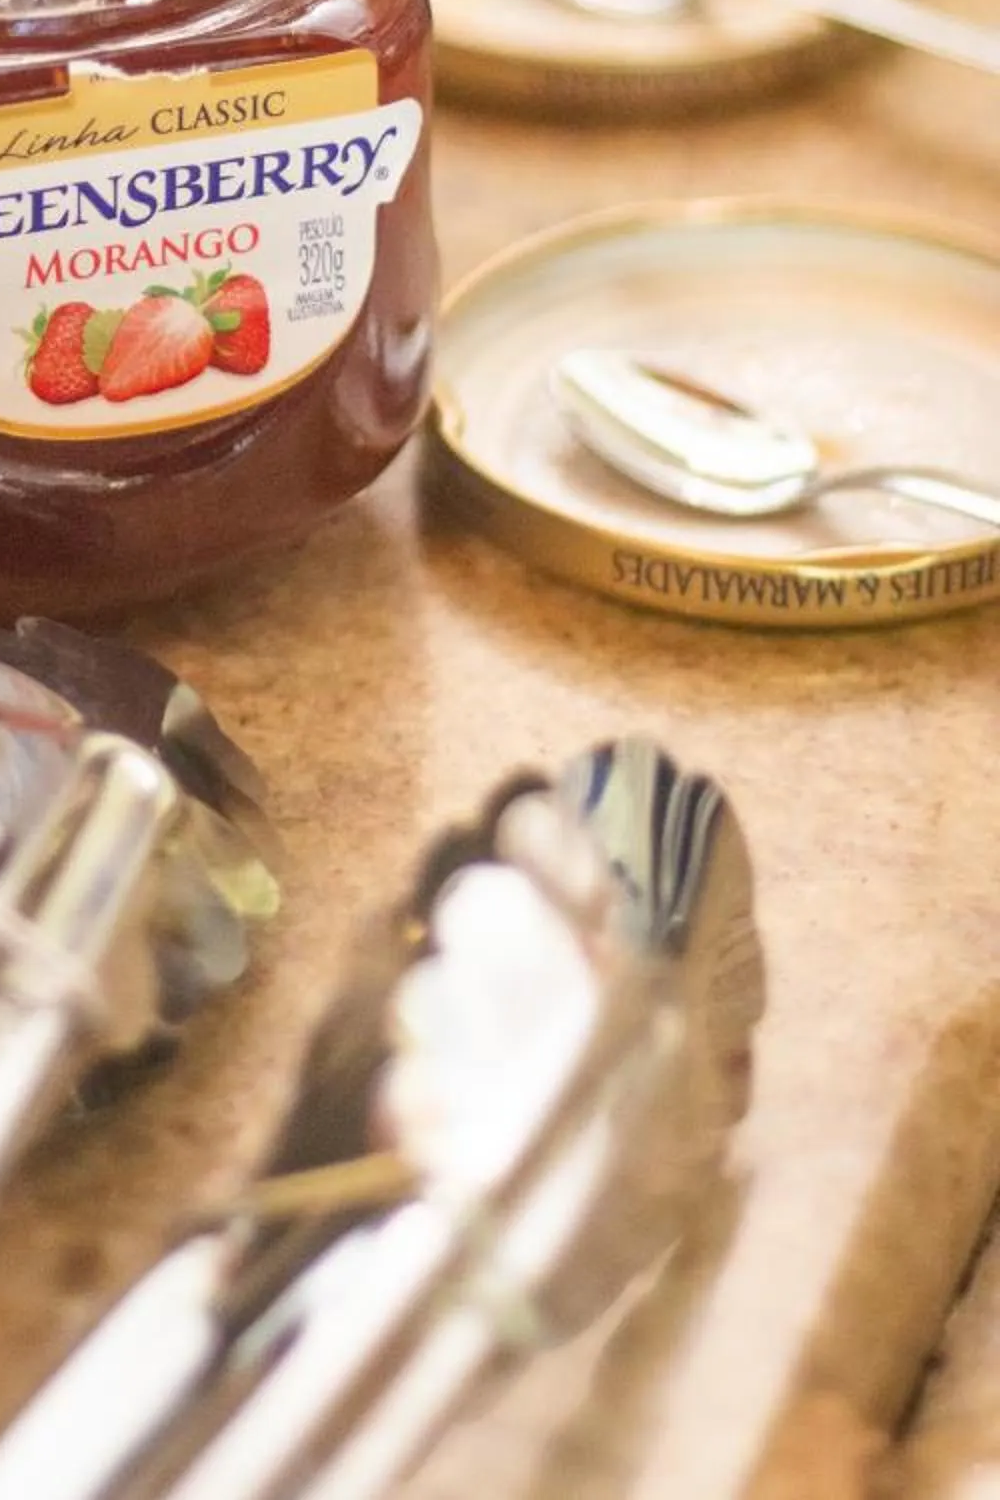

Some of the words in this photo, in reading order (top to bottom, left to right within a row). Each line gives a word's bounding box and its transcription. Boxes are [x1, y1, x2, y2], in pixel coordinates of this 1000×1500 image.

[150, 91, 287, 134] CLASSIC
[24, 222, 260, 290] MORANGO
[298, 241, 345, 291] 320g
[611, 550, 845, 608] MARMALADES
[856, 573, 880, 606] &
